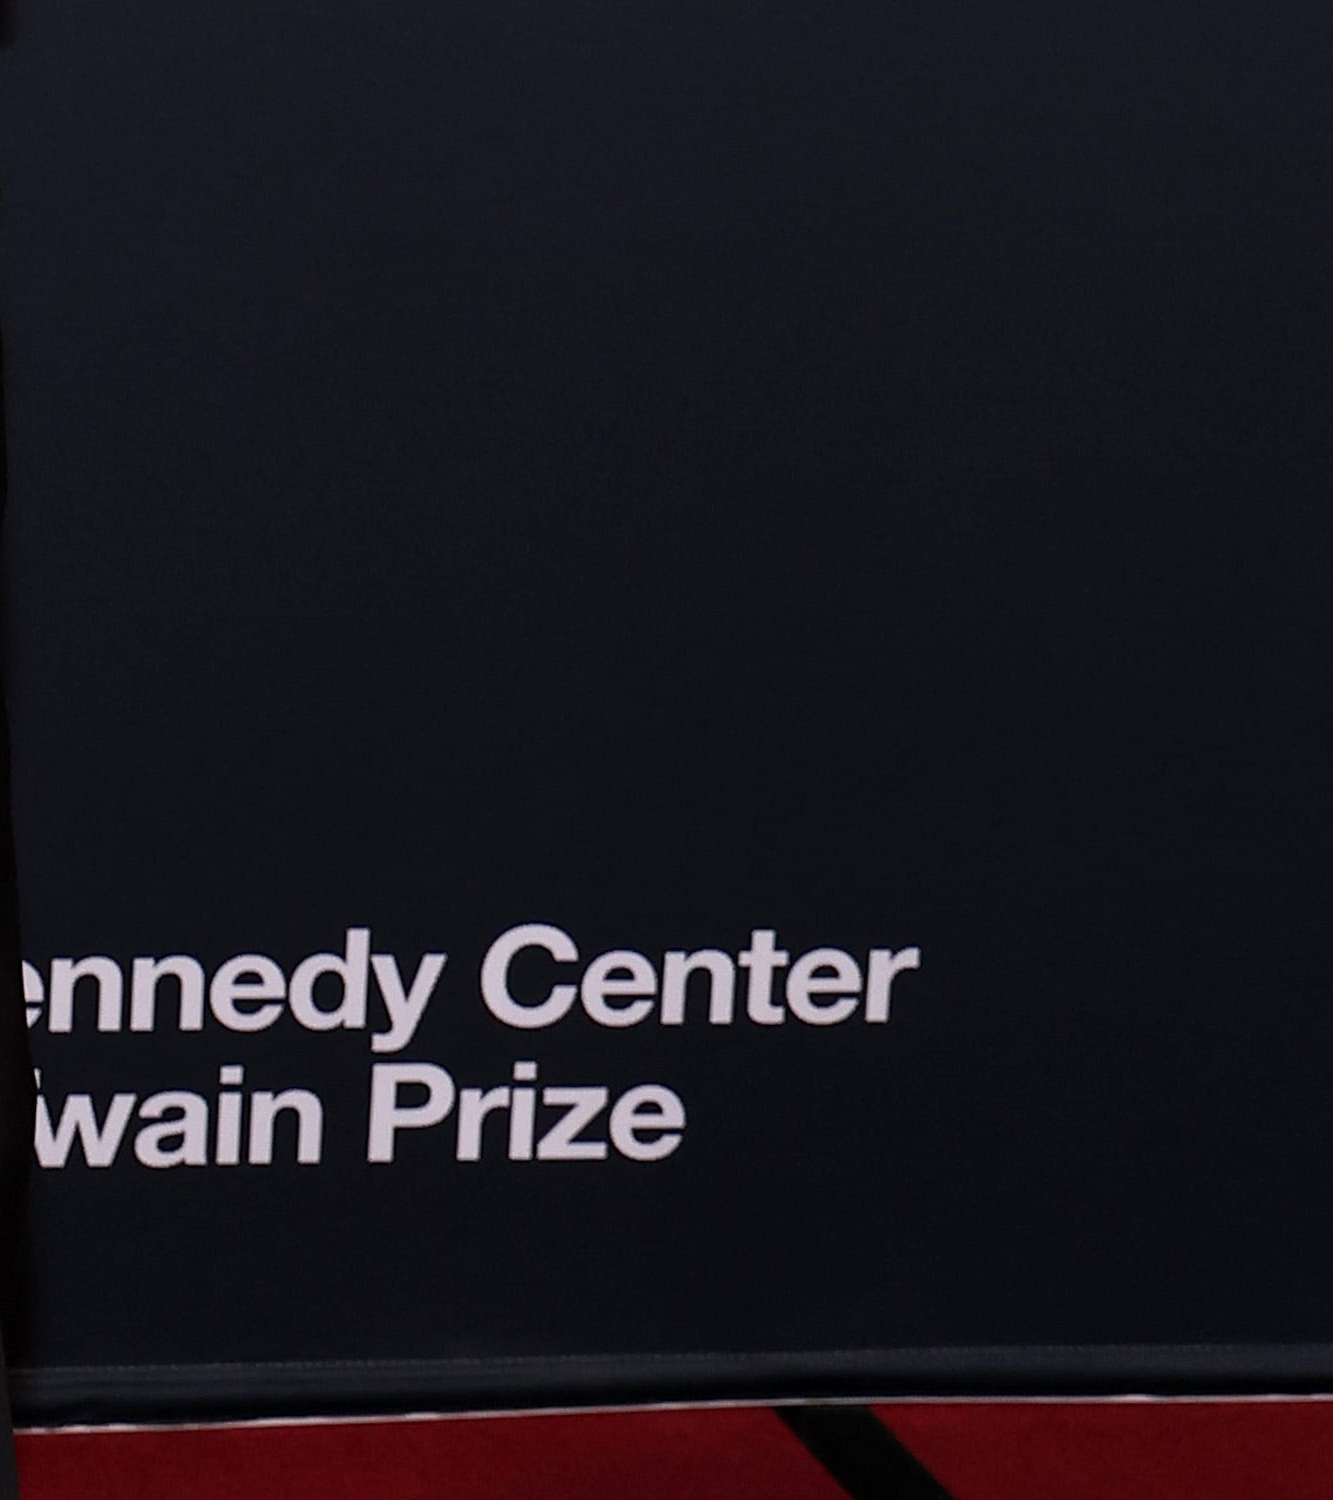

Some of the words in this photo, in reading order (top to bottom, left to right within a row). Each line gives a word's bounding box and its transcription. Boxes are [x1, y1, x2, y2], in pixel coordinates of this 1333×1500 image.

[21, 928, 447, 1054] nnedy
[481, 923, 920, 1030] Center
[34, 1064, 323, 1169] wain
[367, 1060, 685, 1164] Prize
